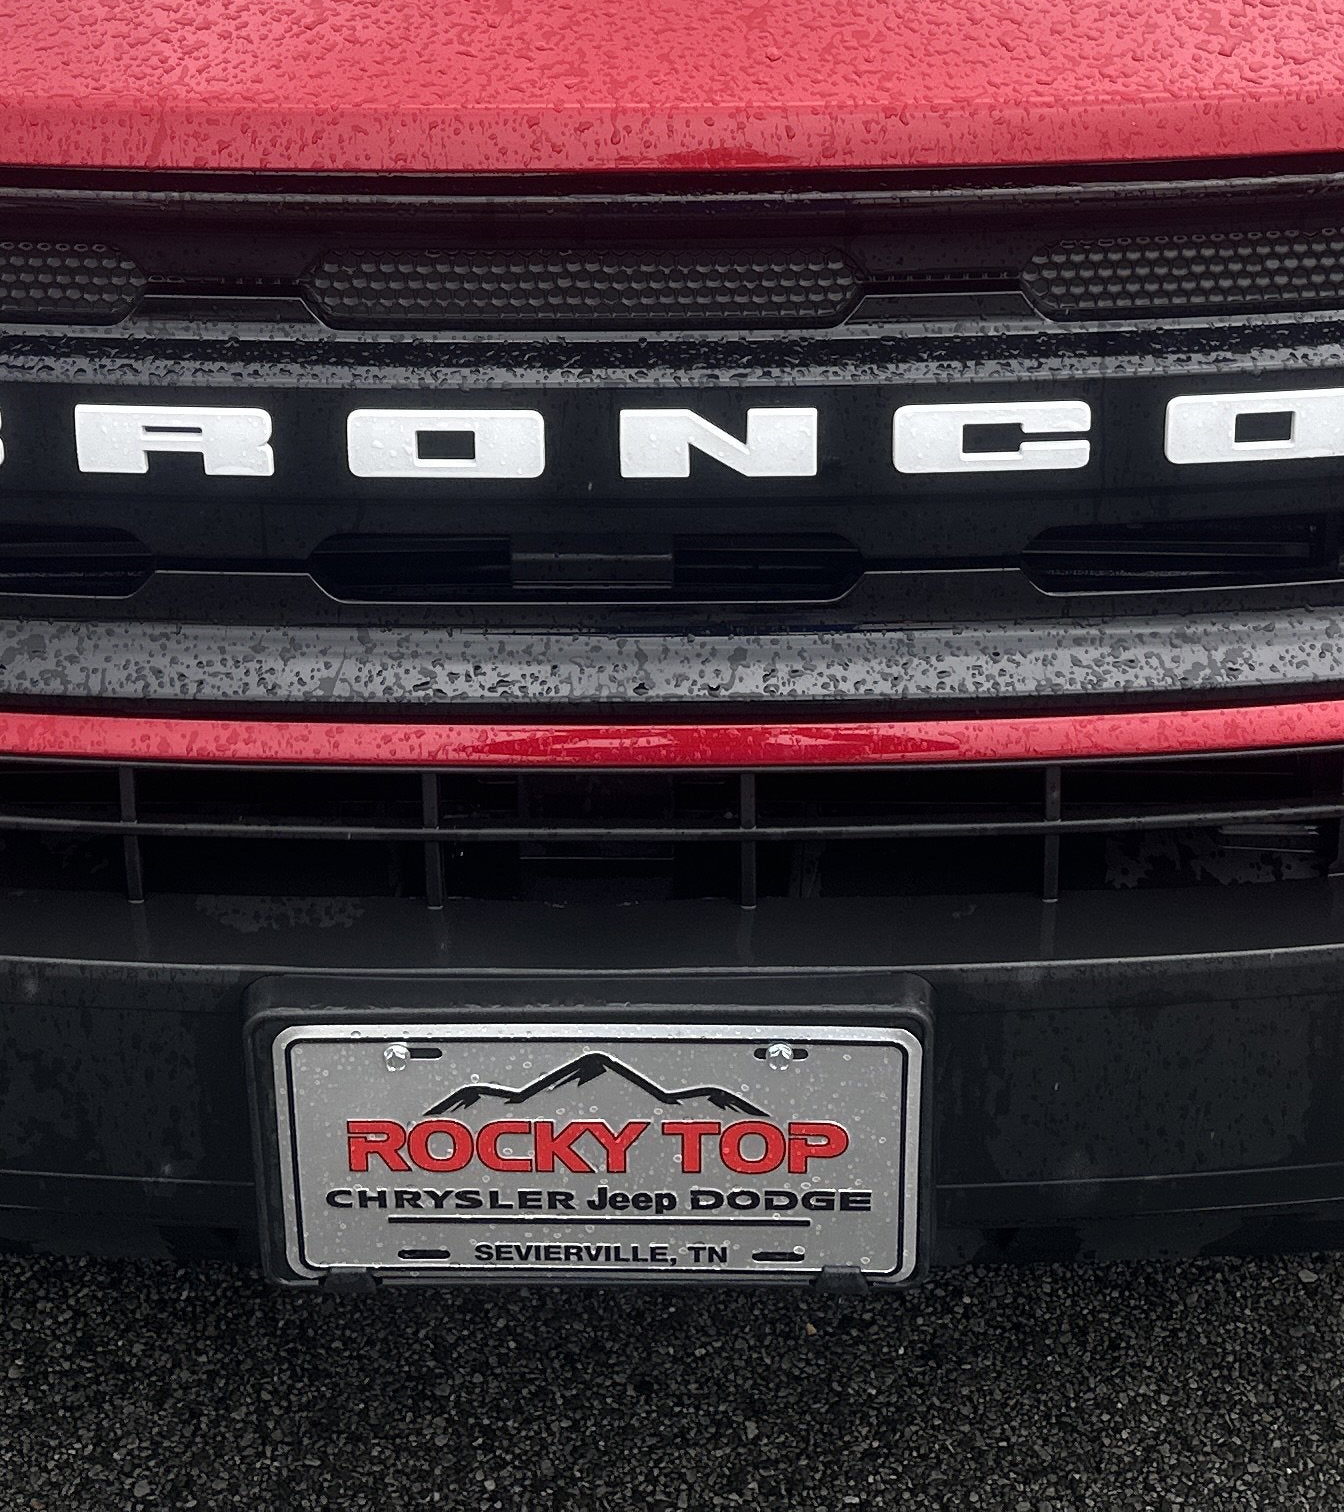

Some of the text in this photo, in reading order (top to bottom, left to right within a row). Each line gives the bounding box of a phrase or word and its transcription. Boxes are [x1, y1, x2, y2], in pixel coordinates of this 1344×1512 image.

[346, 1119, 850, 1175] ROCKY TOP
[325, 1186, 873, 1215] CHRYSLER Jeep DODGE
[474, 1242, 729, 1266] SEVIERVILLE, TN
